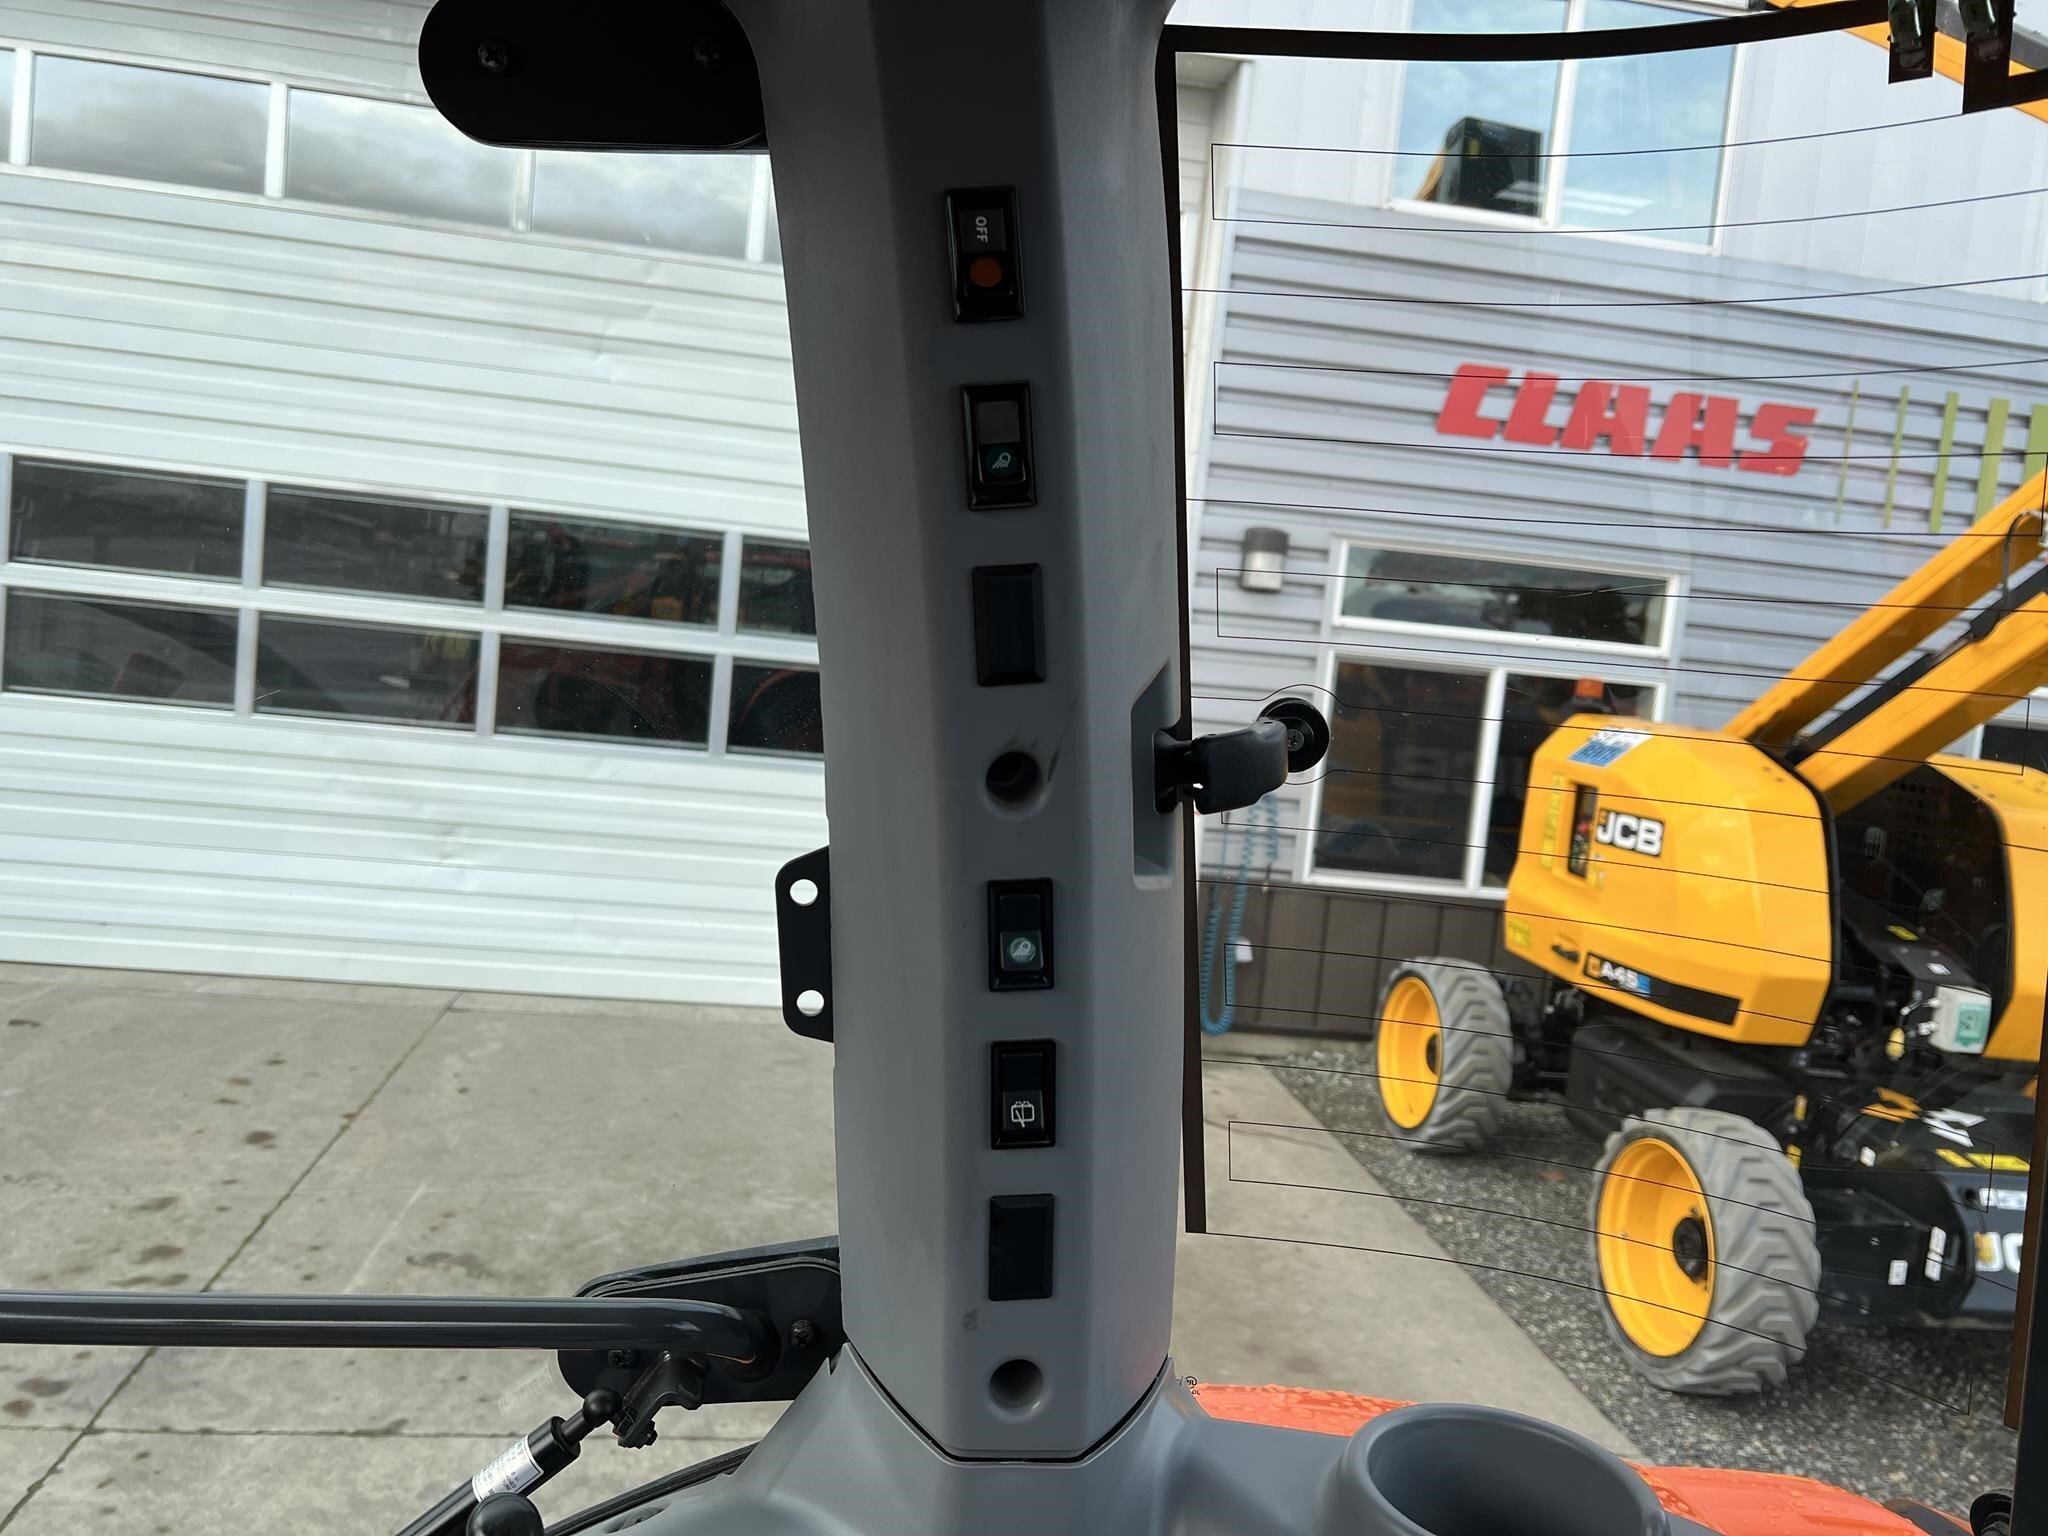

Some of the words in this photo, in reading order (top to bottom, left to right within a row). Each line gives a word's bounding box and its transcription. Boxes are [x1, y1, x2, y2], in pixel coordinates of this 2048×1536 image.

[976, 216, 988, 243] OFF
[1435, 363, 1817, 477] CLAAS
[1596, 811, 1664, 857] JCB
